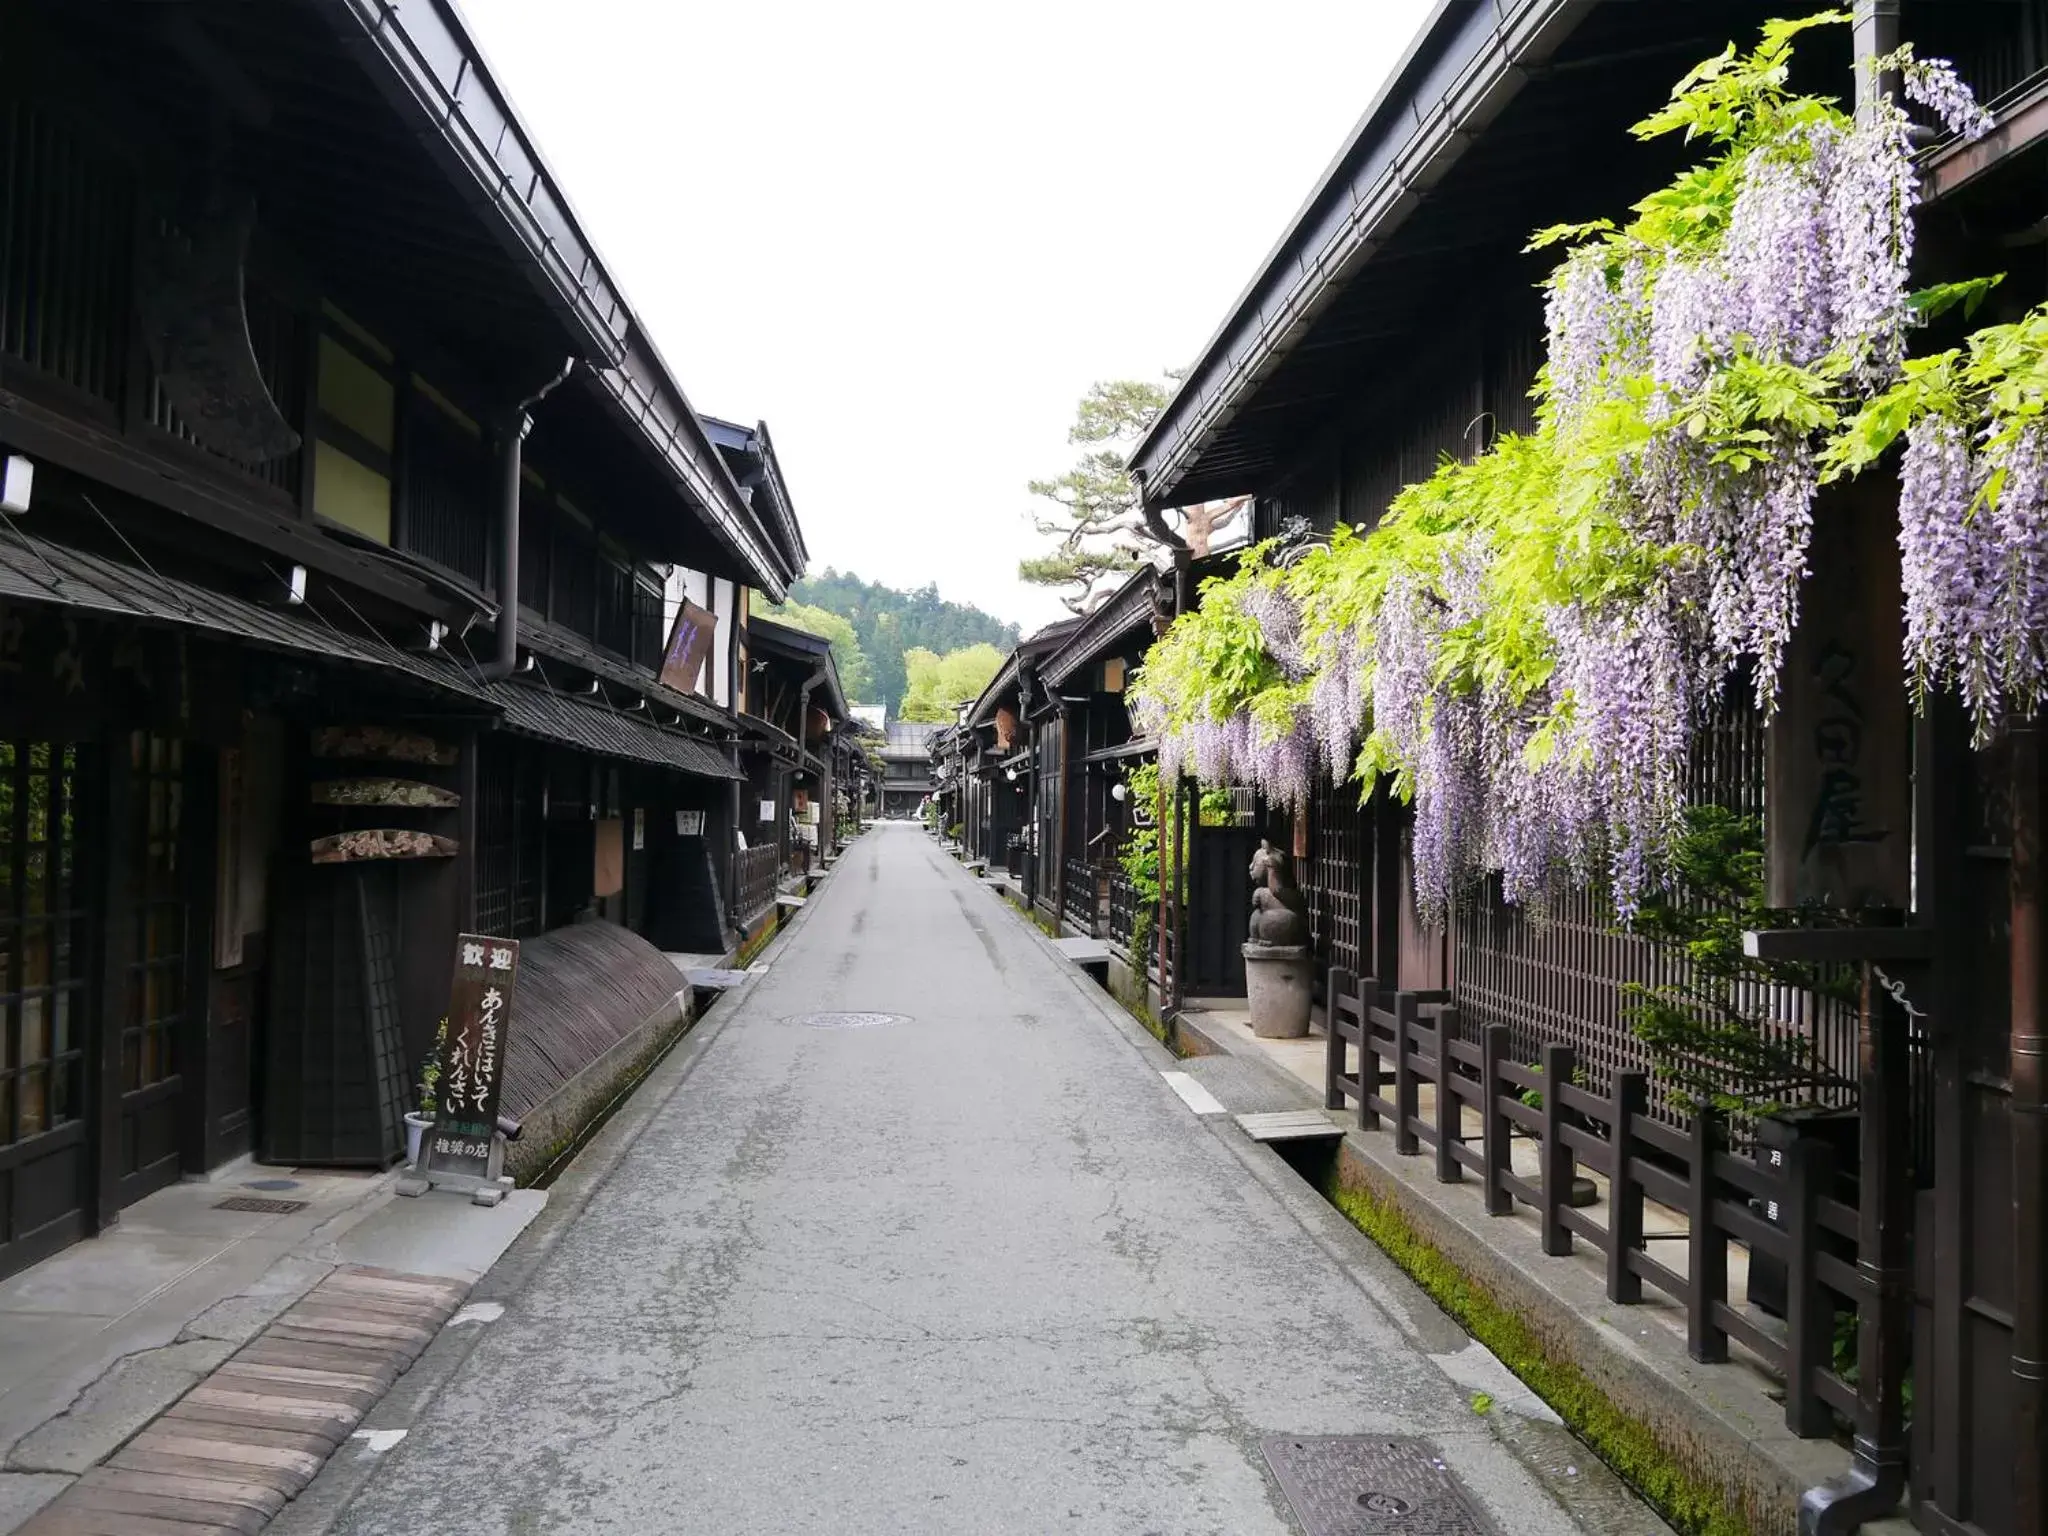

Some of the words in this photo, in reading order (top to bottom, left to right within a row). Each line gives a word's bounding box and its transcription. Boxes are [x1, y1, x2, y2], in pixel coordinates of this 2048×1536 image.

[462, 943, 513, 970] 歓迎
[446, 1026, 471, 1114] くれんさい
[435, 1138, 489, 1158] 推奨の店
